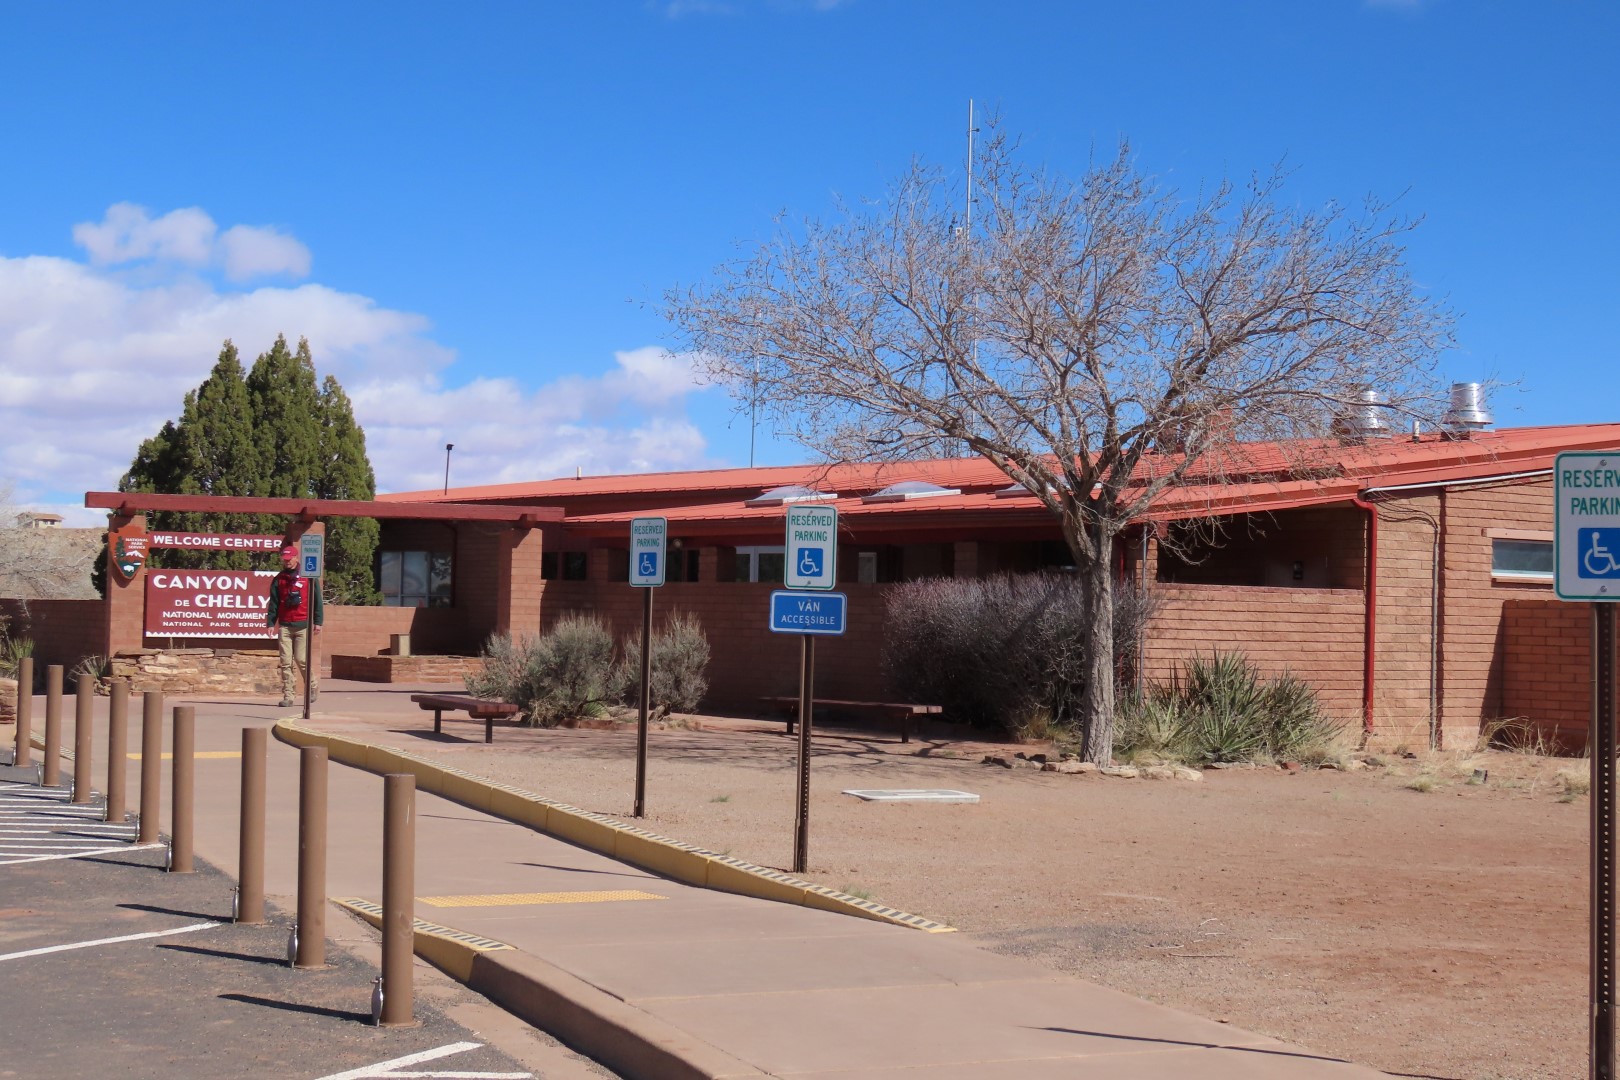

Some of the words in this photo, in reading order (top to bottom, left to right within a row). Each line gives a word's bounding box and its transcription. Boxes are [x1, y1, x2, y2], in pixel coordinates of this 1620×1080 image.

[1563, 470, 1620, 487] RESERV
[1571, 497, 1620, 515] PARKIN
[791, 515, 832, 526] RESERVED
[634, 525, 663, 535] RESERVED
[153, 535, 221, 547] WELCOME
[224, 538, 282, 548] CENTER
[794, 531, 828, 542] PARKING
[637, 538, 660, 547] PARKING
[153, 575, 248, 590] CANYON
[175, 599, 190, 607] DE
[194, 594, 271, 609] CHELLY
[798, 601, 820, 612] VAN
[162, 611, 213, 619] NATIONAL
[781, 615, 835, 625] ACCESSIBLE
